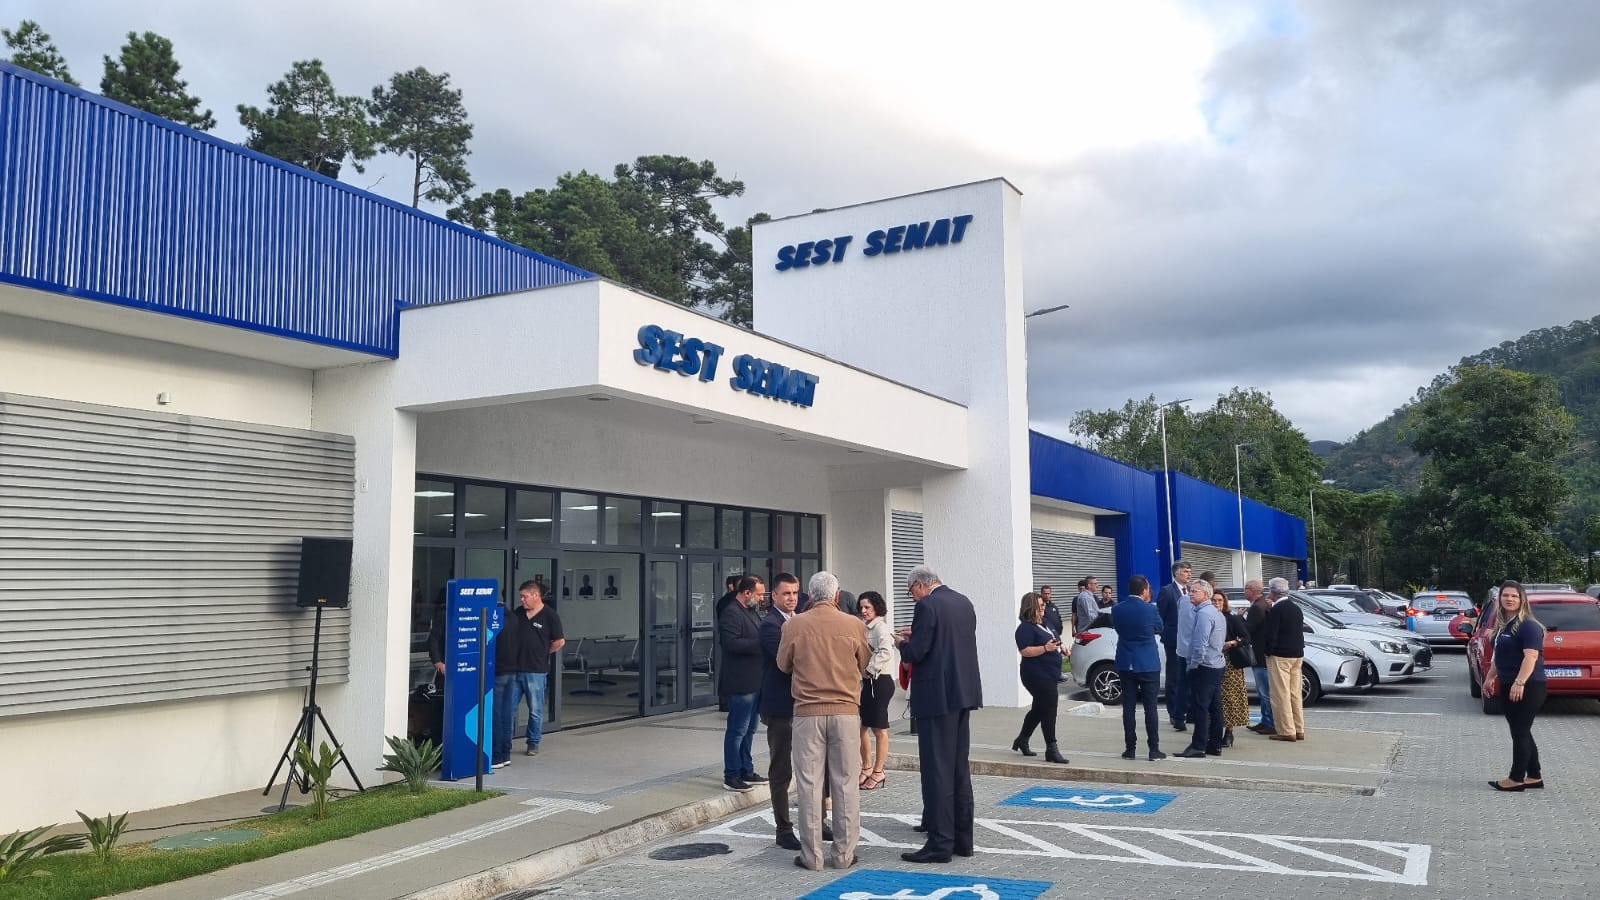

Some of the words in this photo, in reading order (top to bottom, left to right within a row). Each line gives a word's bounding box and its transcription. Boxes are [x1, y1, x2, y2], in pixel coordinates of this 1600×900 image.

[775, 235, 853, 271] SEST
[863, 214, 974, 256] SENAT
[633, 324, 725, 383] SEST
[729, 353, 820, 409] SENAT
